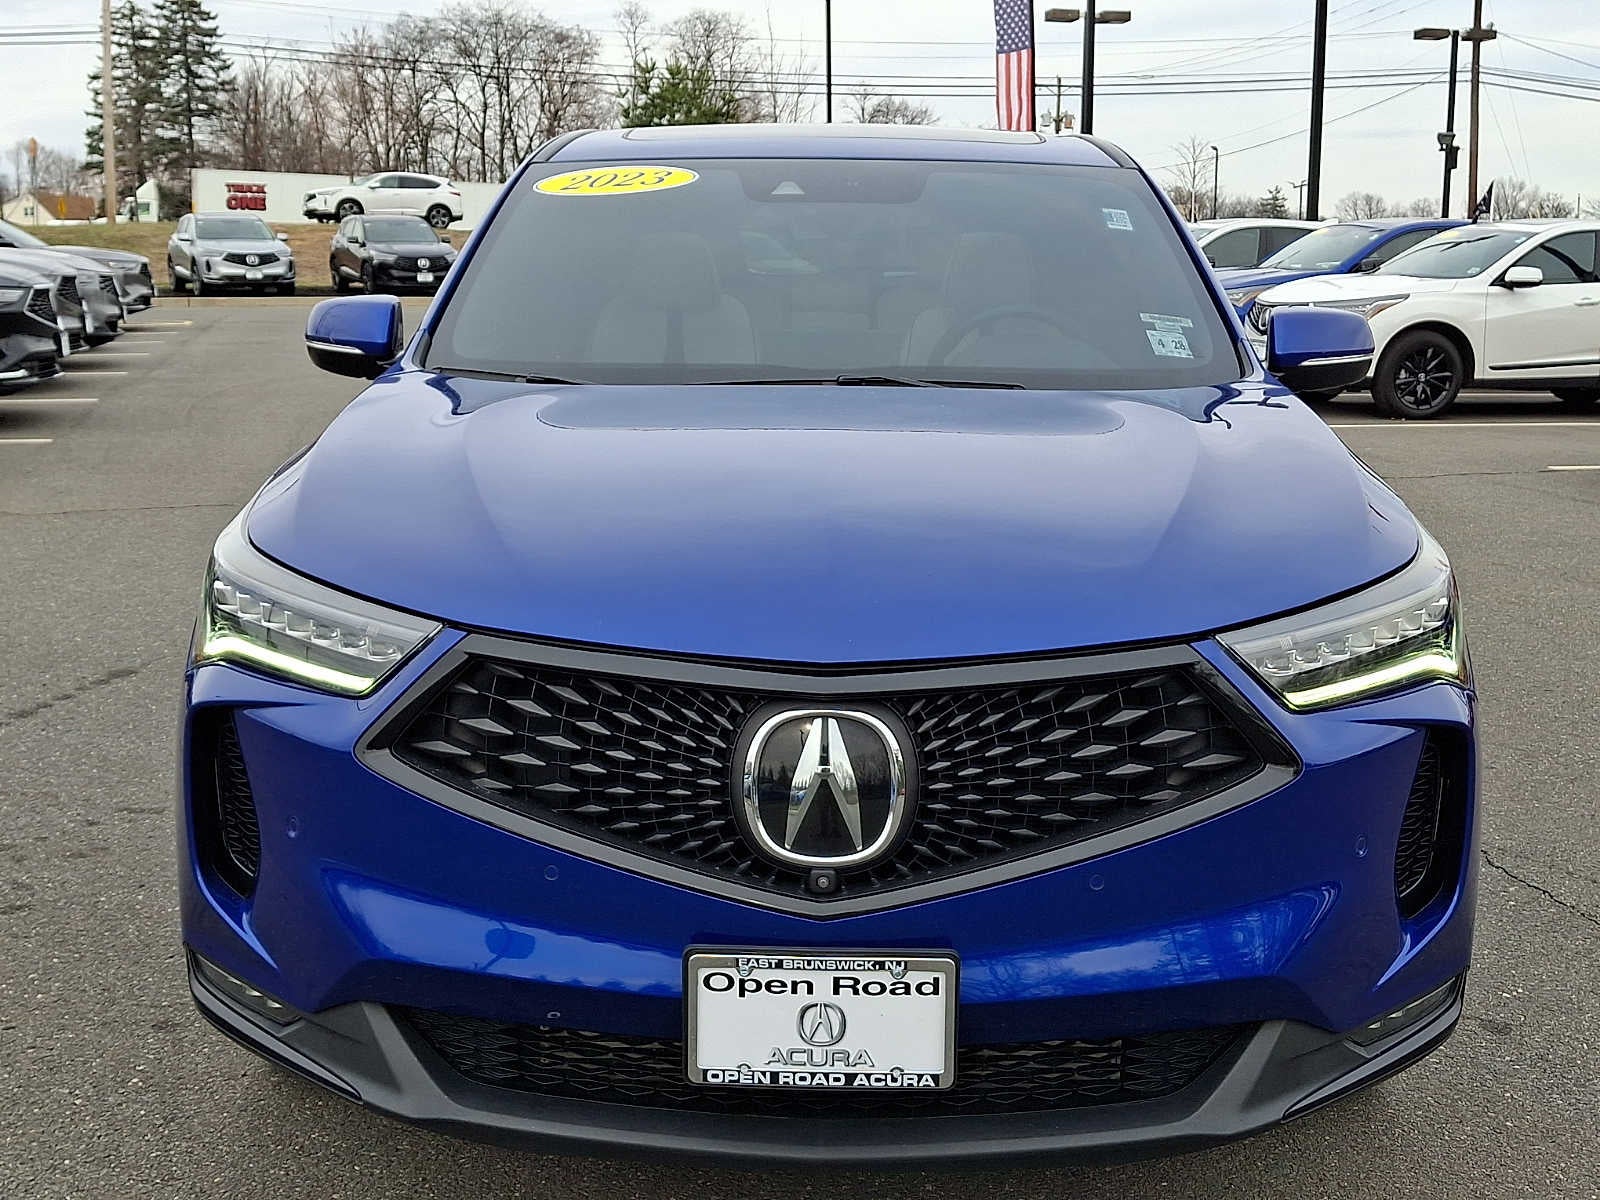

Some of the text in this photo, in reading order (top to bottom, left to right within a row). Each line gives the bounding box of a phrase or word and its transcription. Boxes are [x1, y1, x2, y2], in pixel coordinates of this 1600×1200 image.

[560, 171, 672, 190] 2023
[227, 195, 266, 210] ONE
[1171, 340, 1186, 350] 28
[738, 958, 778, 969] EAST
[884, 960, 905, 971] NJ
[702, 972, 940, 998] Open Road
[763, 1046, 875, 1068] ACURA
[706, 1070, 936, 1088] OPEN ROAD ACURA
